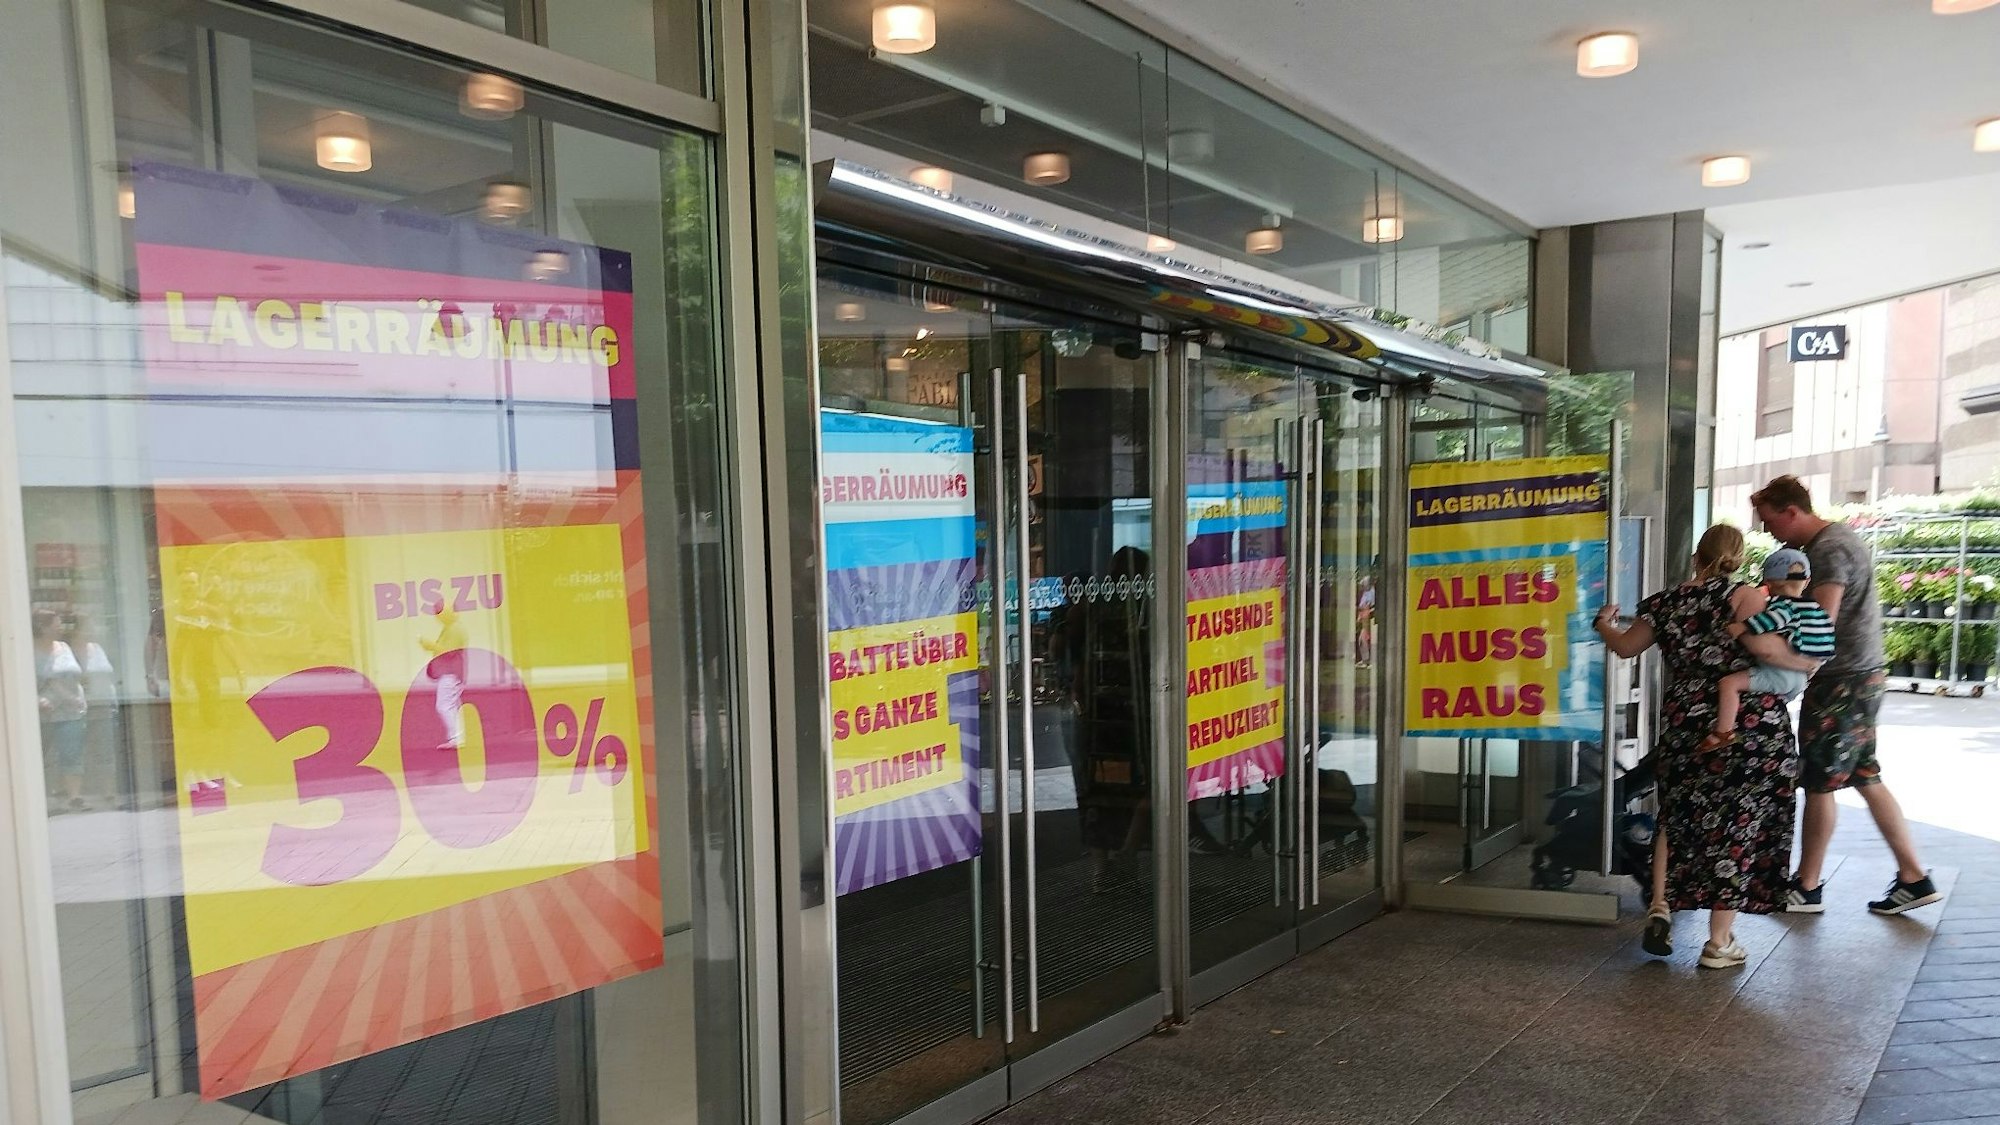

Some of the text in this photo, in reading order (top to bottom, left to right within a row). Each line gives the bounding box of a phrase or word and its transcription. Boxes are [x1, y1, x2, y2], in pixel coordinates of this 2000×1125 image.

[165, 291, 620, 367] LAGERRÄUMUNG
[1798, 331, 1839, 356] C&A
[1416, 484, 1601, 516] LAGERRÄUMUNG
[374, 573, 503, 620] BIS ZU
[1416, 570, 1561, 611] ALLES
[1186, 601, 1274, 643] TAUSENDE
[912, 630, 969, 667] ÜBER
[1418, 626, 1548, 664] MUSS
[1186, 656, 1258, 698] ARTIKEL
[855, 691, 938, 735] GANZE
[1421, 683, 1545, 719] RAUS
[1188, 699, 1280, 751] REDUZIERT
[834, 743, 946, 800] RTIMENT
